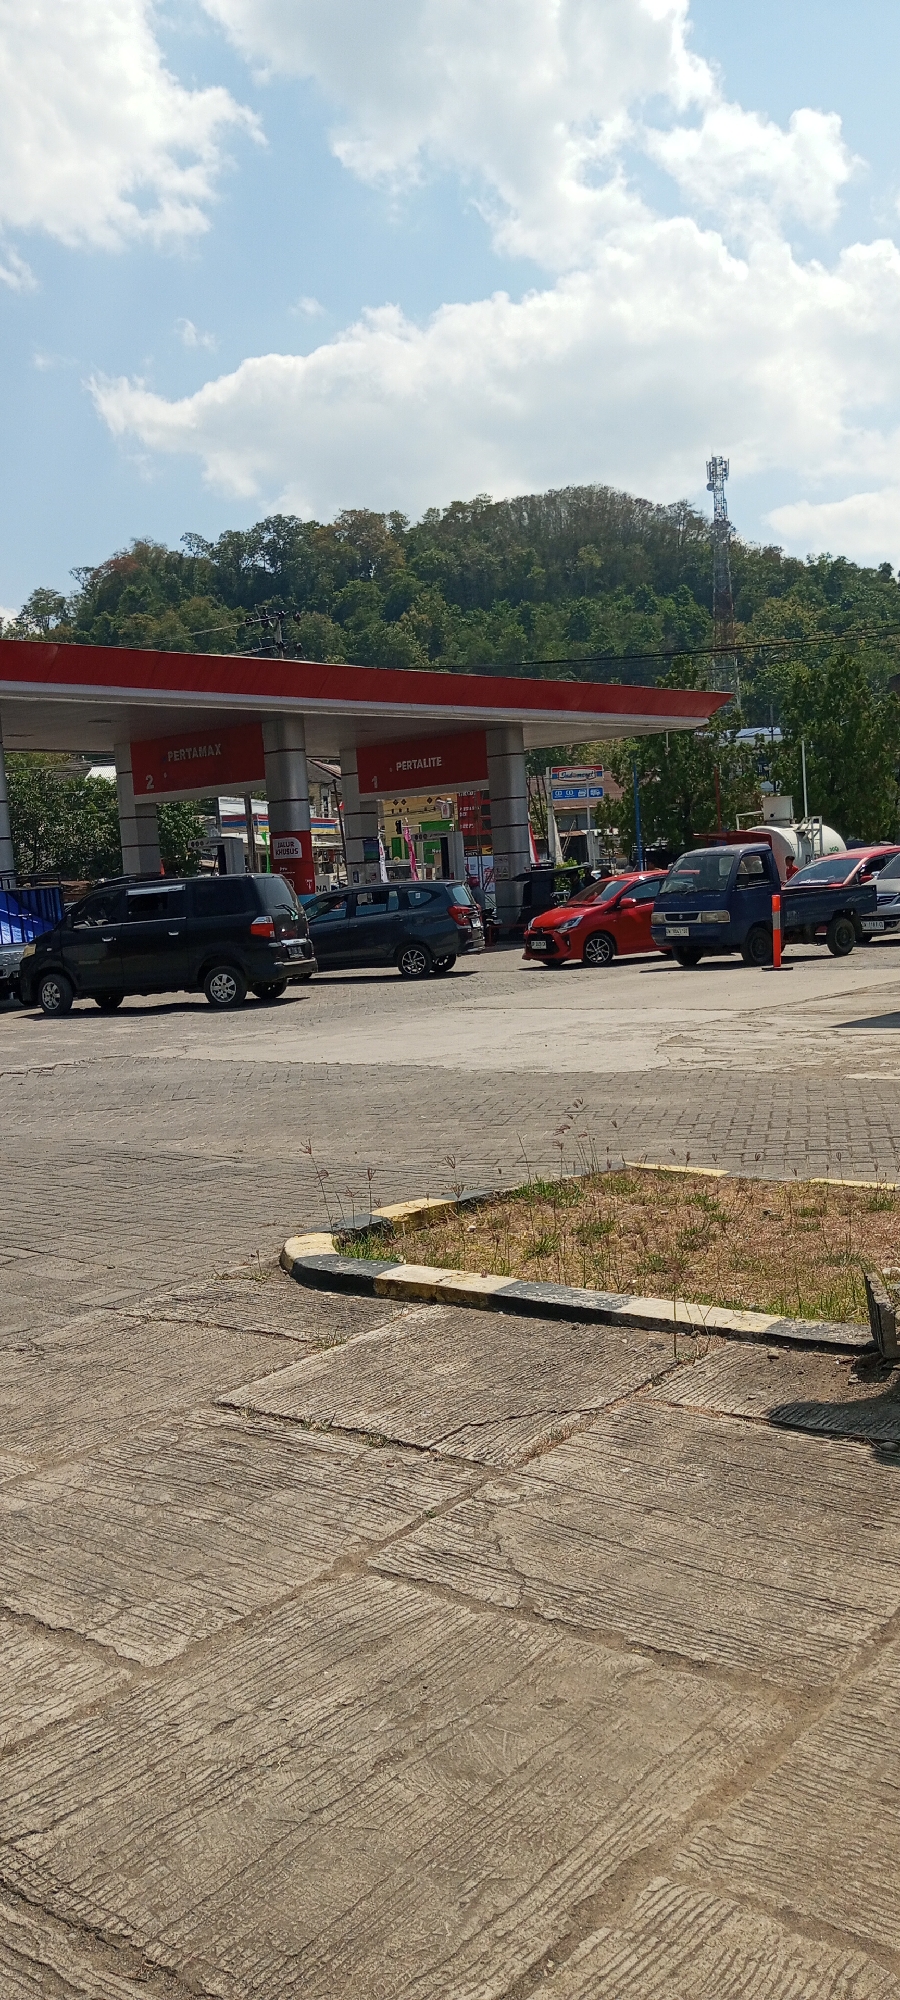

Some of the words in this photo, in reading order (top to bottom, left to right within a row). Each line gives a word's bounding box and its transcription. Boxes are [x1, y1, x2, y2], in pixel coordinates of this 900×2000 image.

[167, 743, 222, 762] PERTAMAX
[396, 756, 442, 771] PERTALITE
[145, 774, 154, 790] 2
[371, 775, 378, 789] 1
[275, 847, 299, 856] KHUSUS
